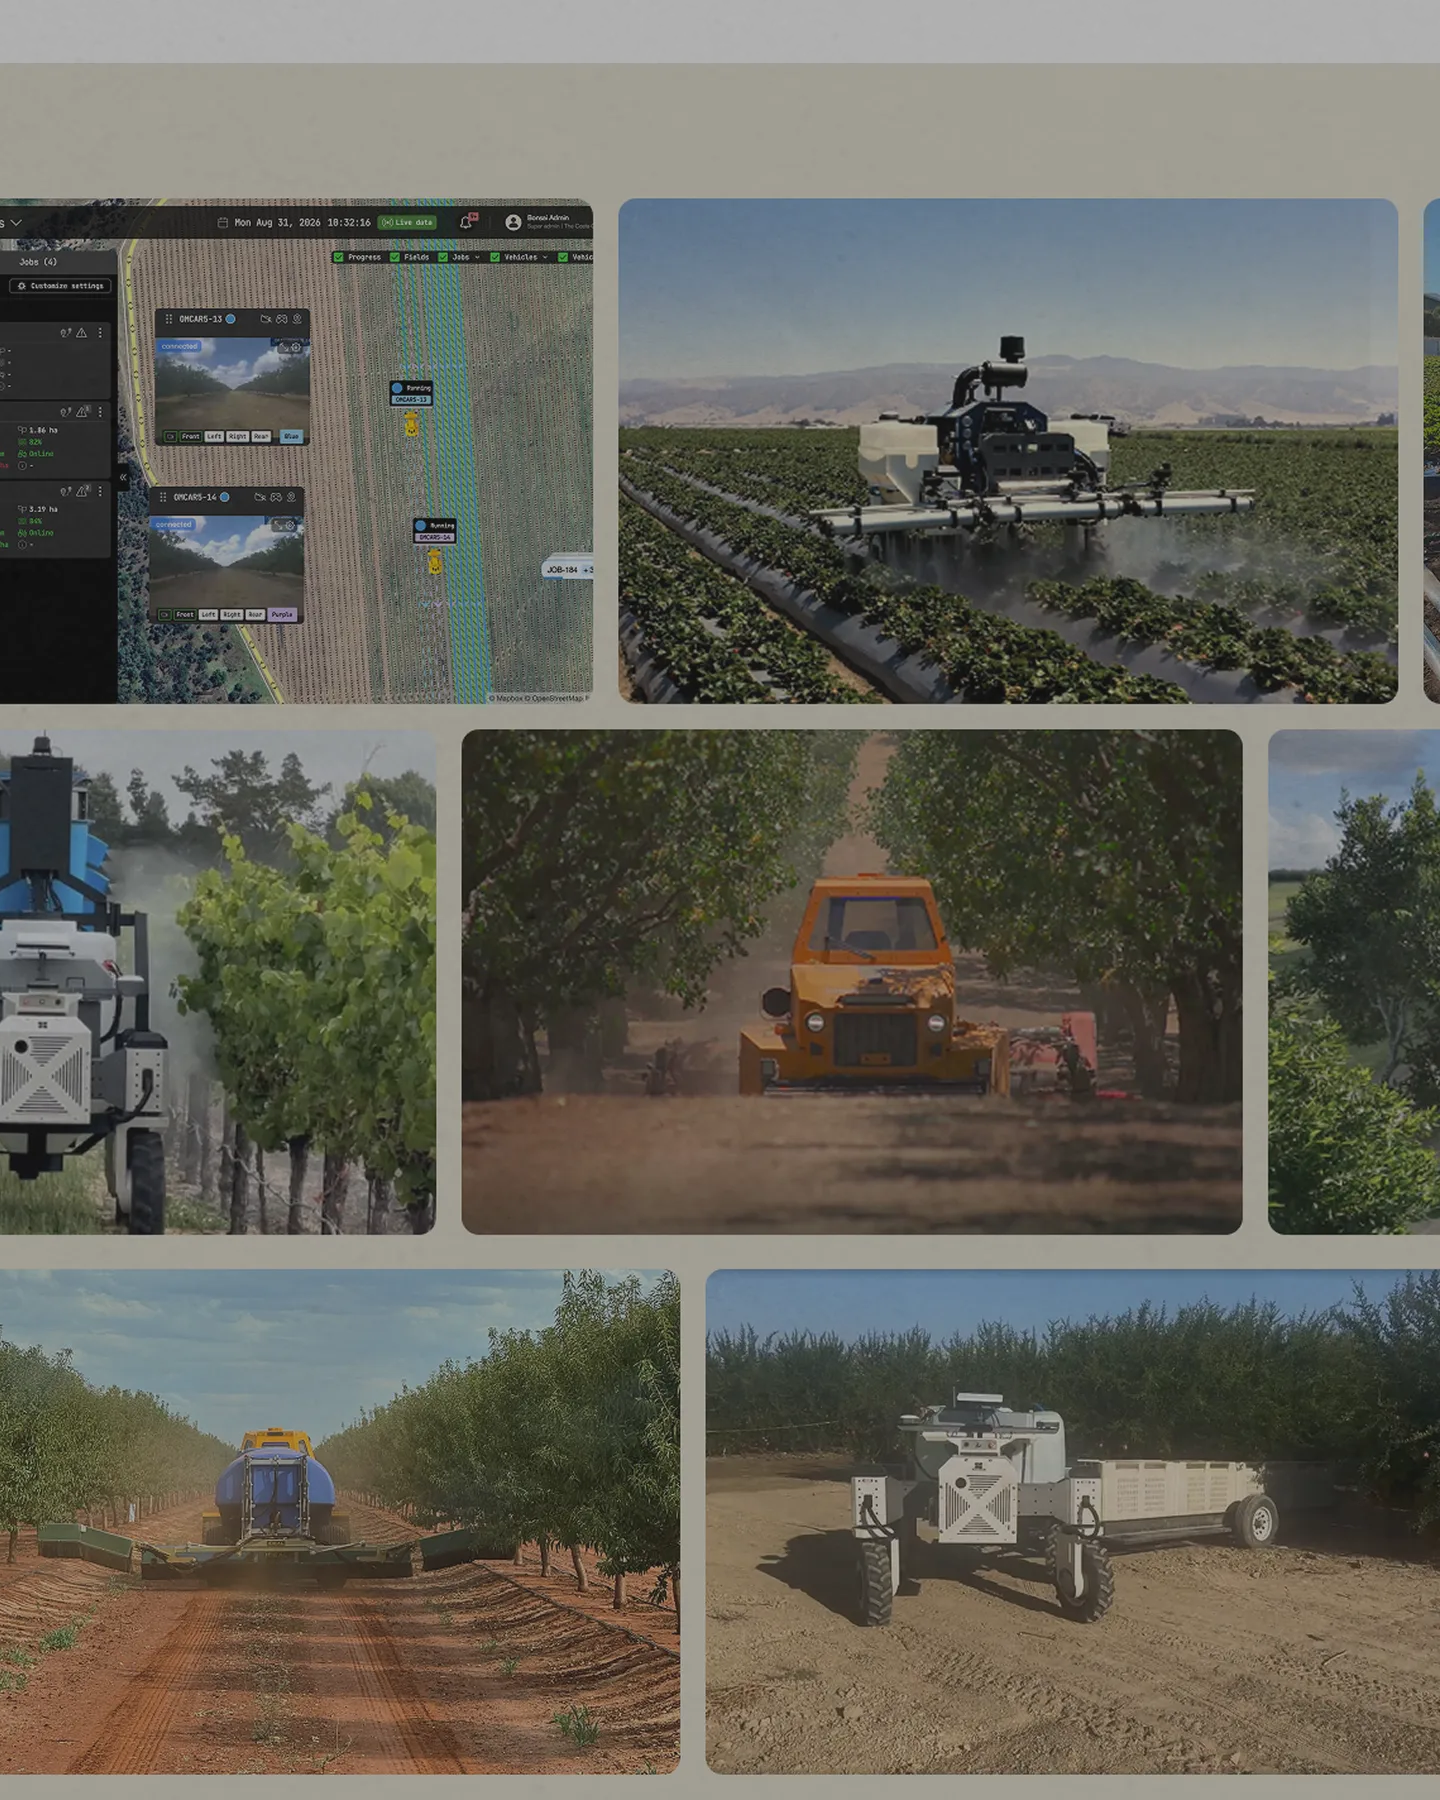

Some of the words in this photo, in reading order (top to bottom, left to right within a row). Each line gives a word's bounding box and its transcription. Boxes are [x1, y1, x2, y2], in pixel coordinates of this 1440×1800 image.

[257, 219, 272, 228] Aug
[278, 218, 292, 227] 31,
[300, 218, 320, 226] 2026
[44, 258, 57, 266] (4)
[349, 254, 381, 262] Progress
[161, 342, 199, 351] connected
[227, 433, 248, 441] Right
[155, 520, 191, 529] connected
[495, 695, 522, 704] Mapbox
[532, 694, 585, 704] OpenStreetMap
